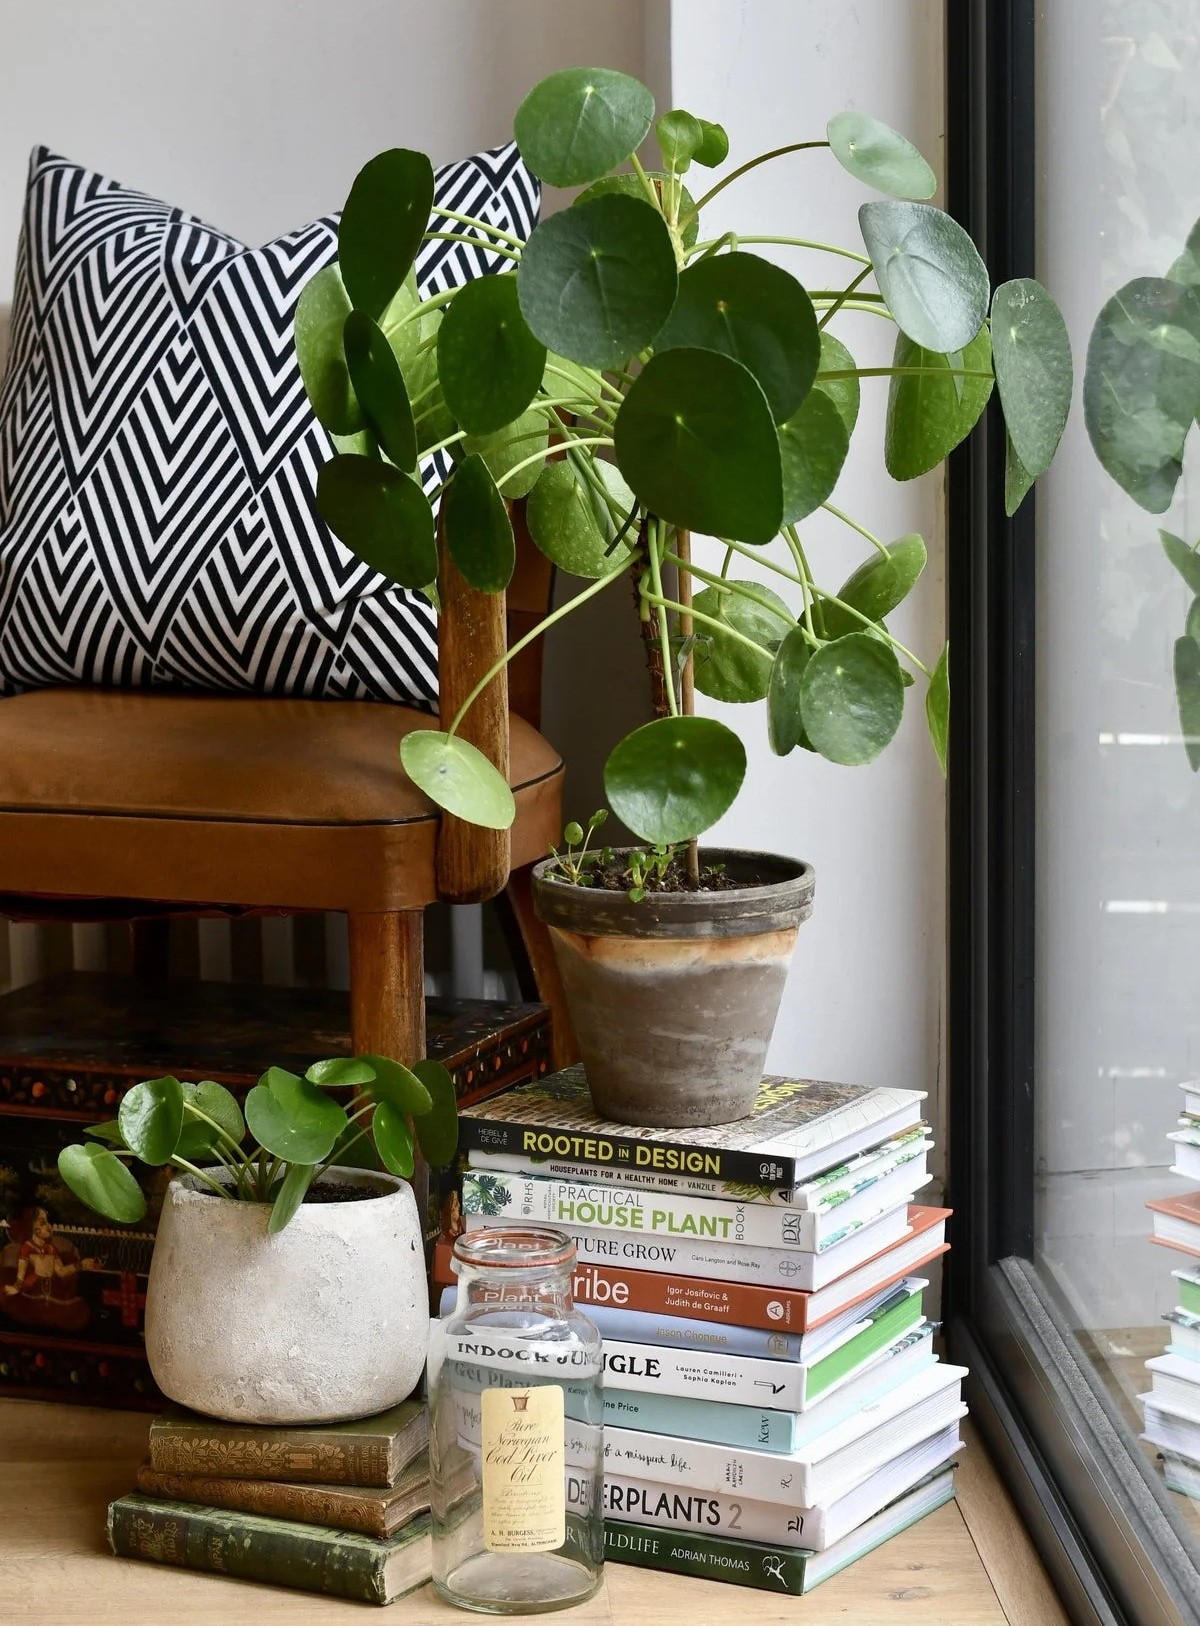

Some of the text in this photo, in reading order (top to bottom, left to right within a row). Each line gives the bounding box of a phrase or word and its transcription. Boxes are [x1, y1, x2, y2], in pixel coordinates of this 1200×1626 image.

[478, 1128, 501, 1138] HEIBEL
[480, 1135, 508, 1146] DE GIVE
[523, 1131, 721, 1175] ROOTED IN DESIGN
[550, 1164, 598, 1177] HOUSEPLANTS
[600, 1170, 614, 1179] FOR
[624, 1173, 656, 1184] HEALTHY
[658, 1178, 679, 1188] HOME
[687, 1181, 717, 1192] VANZILE
[523, 1182, 534, 1204] RHS
[558, 1185, 644, 1207] PRACTICAL
[558, 1200, 733, 1239] HOUSE PLANT
[735, 1205, 746, 1241] BOOK
[782, 1214, 800, 1245] DK
[571, 1236, 677, 1262] TURE GROW
[691, 1254, 761, 1270] Caro Langton and Rose Ray
[572, 1268, 629, 1304] ribe
[667, 1285, 729, 1301] Igor Josifovic &
[665, 1298, 730, 1313] Judith de Graaff
[656, 1326, 728, 1344] Jason Chongue
[676, 1365, 737, 1378] Lauren Camilleri
[683, 1374, 737, 1387] Sophia Kaplan
[617, 1402, 640, 1413] Price
[507, 1418, 537, 1431] Pure
[758, 1414, 770, 1444] Kew
[488, 1432, 550, 1448] Norwegian
[485, 1446, 557, 1465] Cod Liver
[625, 1450, 668, 1467] misspent
[671, 1454, 692, 1473] life.
[510, 1463, 537, 1482] Oil
[727, 1503, 743, 1530] 2
[671, 1548, 706, 1564] ADRIAN
[709, 1554, 750, 1572] THOMAS
